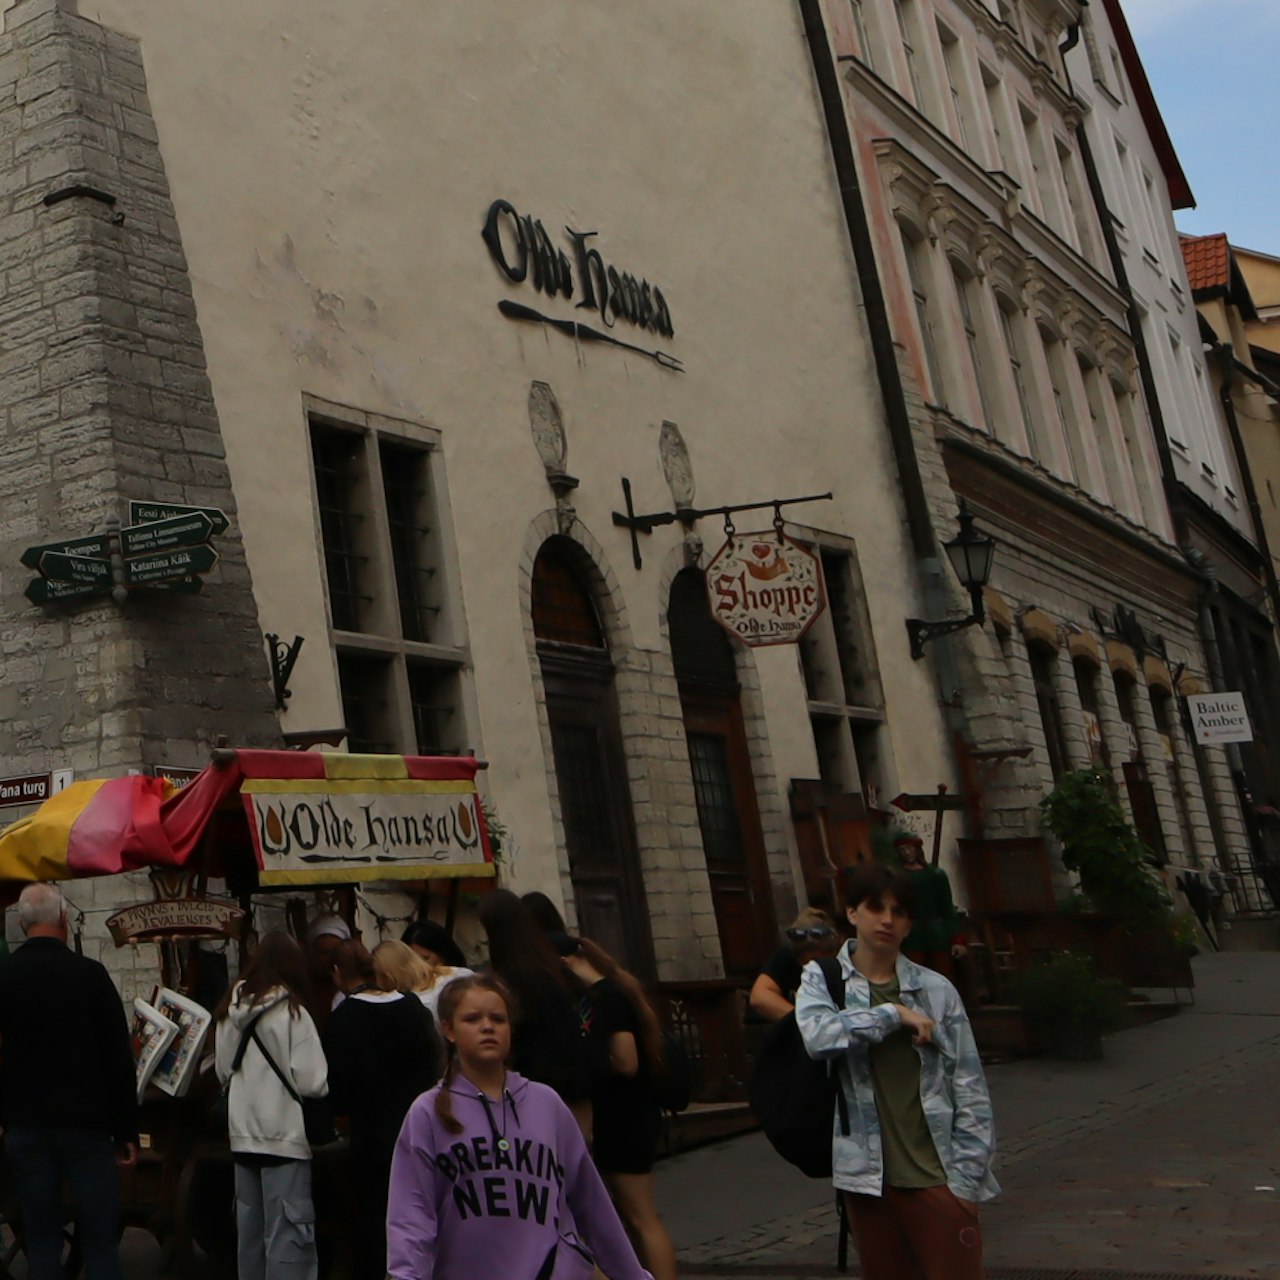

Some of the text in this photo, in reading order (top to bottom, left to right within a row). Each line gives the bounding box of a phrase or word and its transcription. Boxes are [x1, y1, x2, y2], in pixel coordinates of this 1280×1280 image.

[130, 552, 191, 572] Katariina Käik
[714, 570, 815, 617] Shoppe
[1196, 701, 1240, 714] Baltic
[1197, 715, 1246, 728] Amber
[23, 781, 46, 797] turg
[59, 777, 64, 790] 1
[290, 794, 357, 851] Olde
